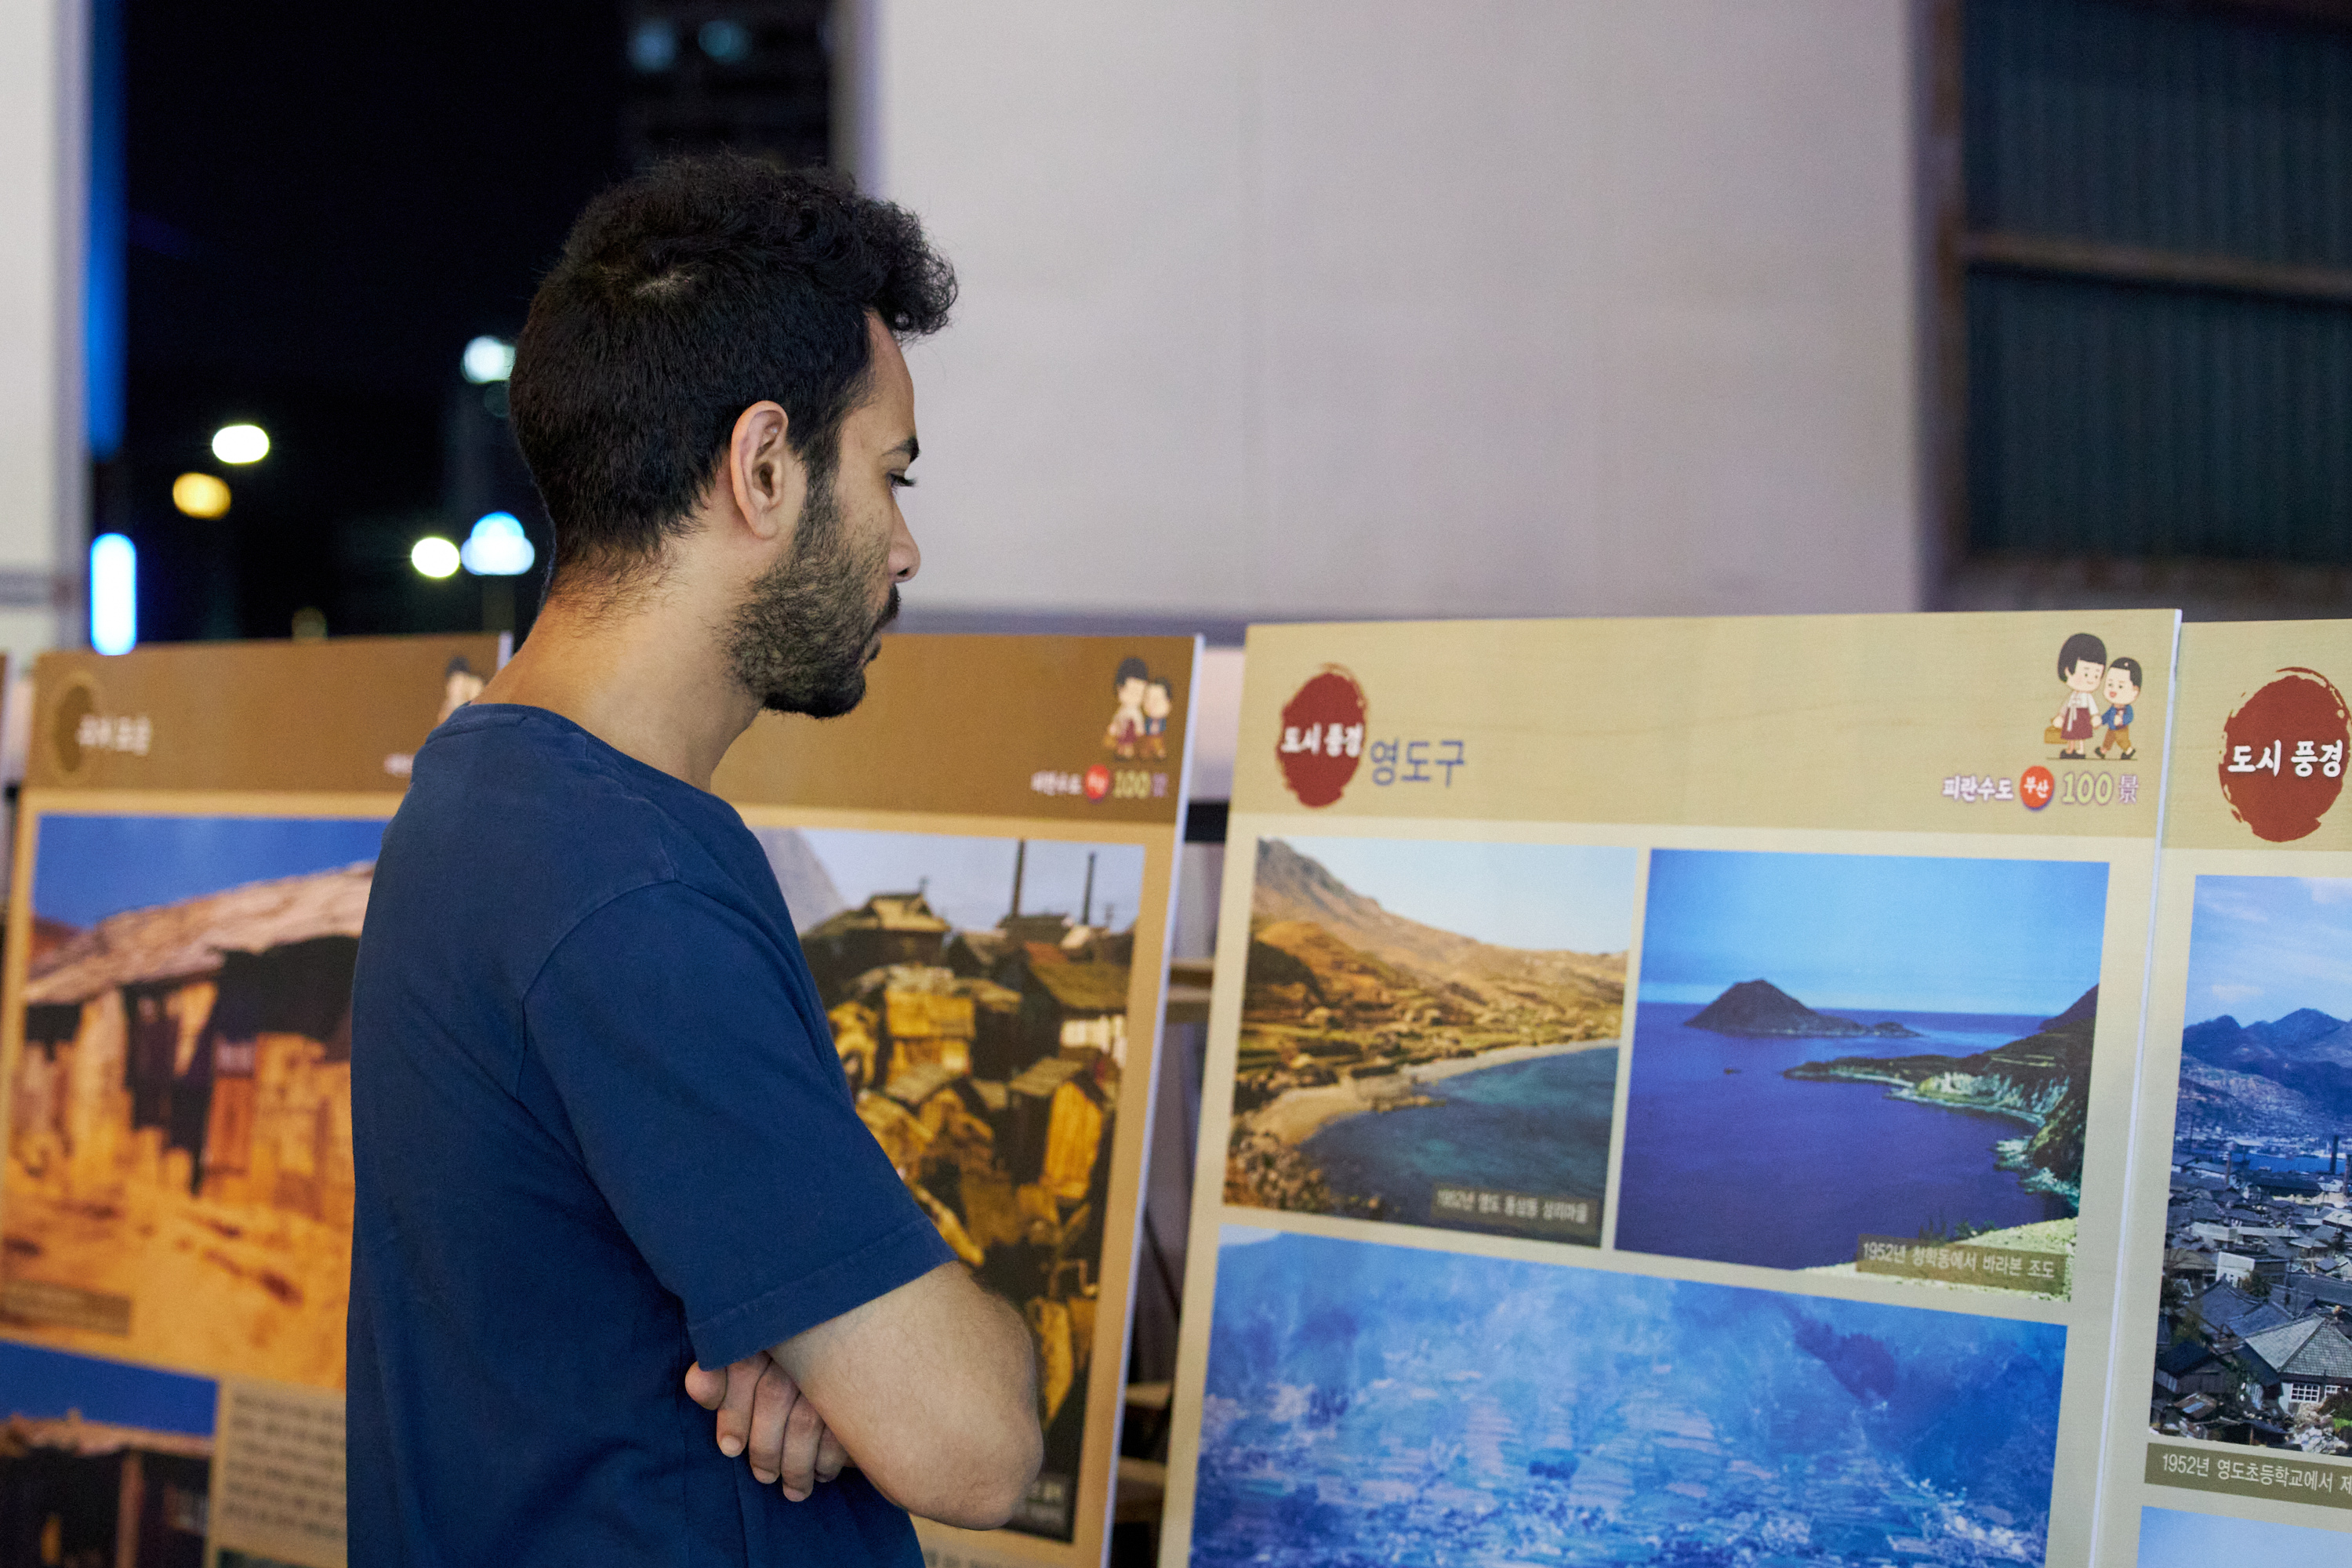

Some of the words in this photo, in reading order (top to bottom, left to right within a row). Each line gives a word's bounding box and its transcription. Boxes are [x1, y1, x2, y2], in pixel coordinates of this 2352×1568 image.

[1370, 737, 1465, 787] 영도구
[2227, 739, 2282, 778] 도시
[2290, 739, 2344, 779] 풍경
[1941, 774, 2013, 802] 피란수도
[2023, 775, 2050, 799] 부산
[1863, 1242, 1906, 1264] 1952년
[1913, 1246, 1976, 1272] 청학동에서
[1982, 1256, 2023, 1276] 바라본
[2027, 1259, 2054, 1278] 조도
[2162, 1453, 2209, 1478] 1952년
[2217, 1459, 2333, 1494] 영도초등학교에서
